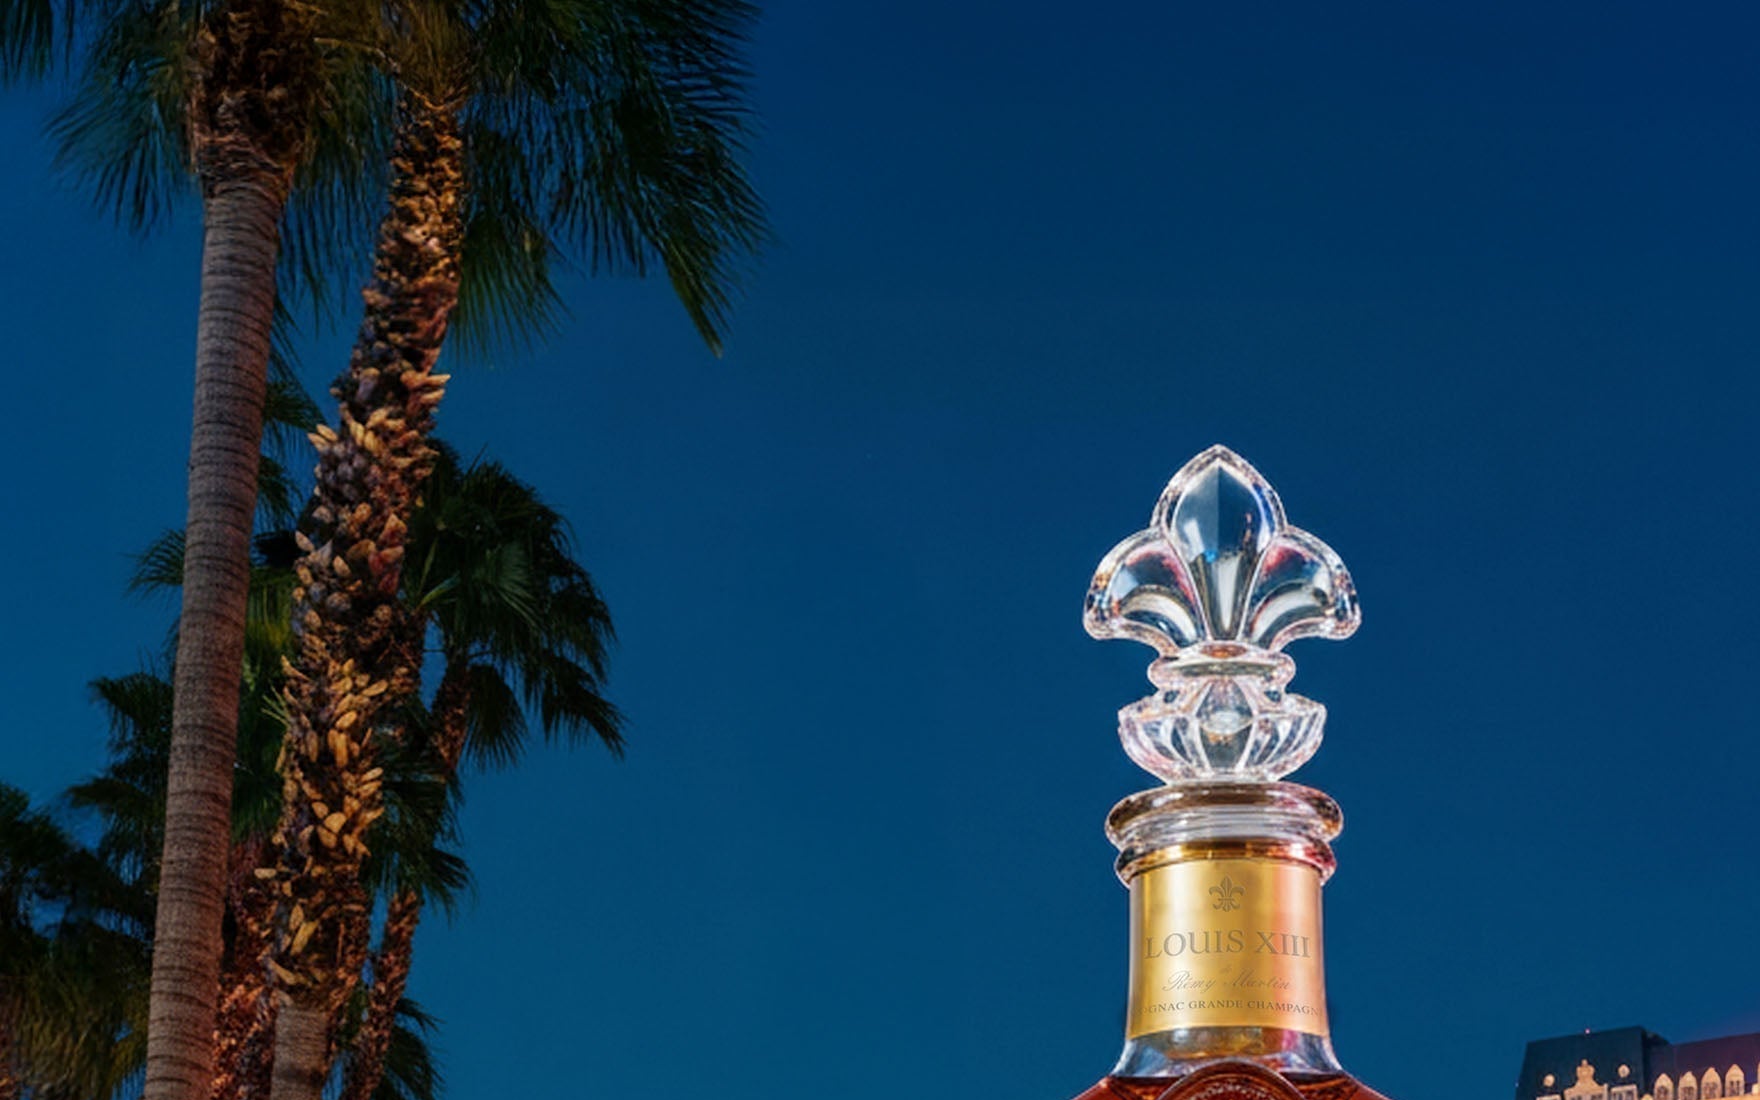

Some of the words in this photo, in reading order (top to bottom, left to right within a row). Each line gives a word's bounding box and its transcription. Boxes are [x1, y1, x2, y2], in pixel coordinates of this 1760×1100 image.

[1144, 929, 1244, 960] LOUIS
[1255, 931, 1312, 958] XIII
[1137, 1001, 1185, 1015] OGNAC
[1188, 999, 1243, 1010] GRANDE
[1247, 1000, 1321, 1017] CHAMPAGN
